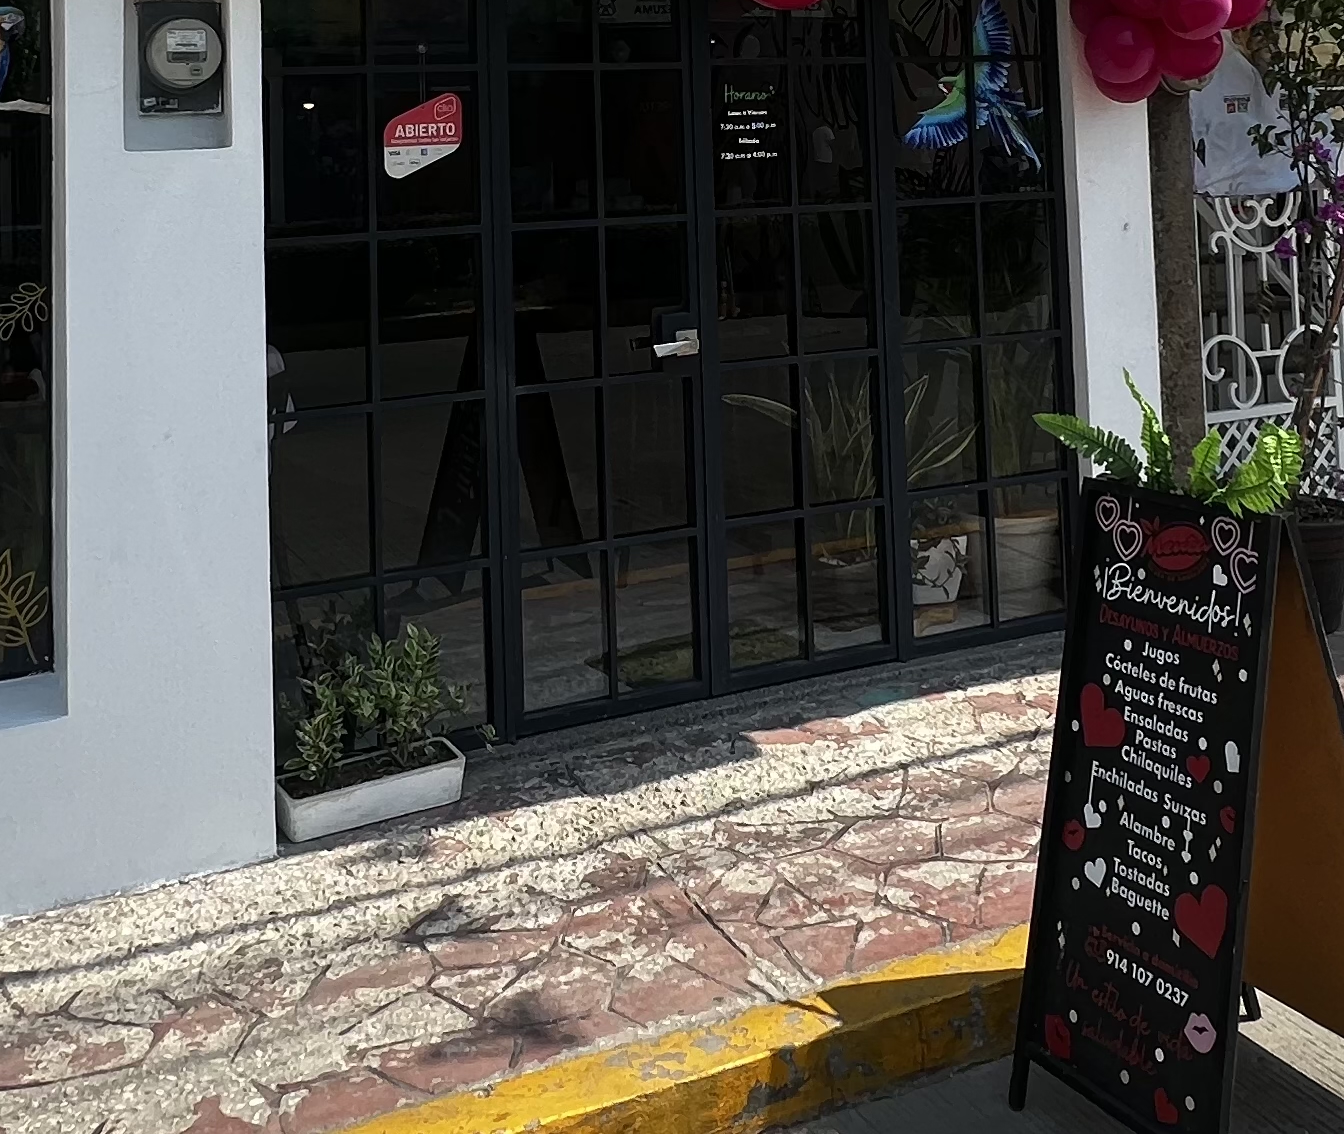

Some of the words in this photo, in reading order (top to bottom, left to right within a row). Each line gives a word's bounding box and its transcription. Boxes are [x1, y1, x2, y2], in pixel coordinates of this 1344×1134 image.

[394, 122, 456, 138] ABIERTO
[1142, 641, 1180, 665] Jugos
[1105, 652, 1156, 685] Cócteles
[1159, 671, 1176, 690] de
[1178, 677, 1218, 704] frutas
[1114, 679, 1155, 706] Aguas
[1157, 692, 1204, 723] frescas
[1123, 705, 1189, 743] Ensaladas
[1135, 729, 1177, 759] Pastas
[1092, 760, 1159, 803] Enchiladas
[1121, 745, 1193, 789] Chilaquiles
[1119, 811, 1176, 851] Alambre
[1127, 839, 1163, 869] Tacos
[1112, 856, 1170, 897] Tostadas
[1111, 876, 1170, 921] Baguette
[1106, 948, 1128, 974] 914
[1131, 962, 1155, 987] 107
[1155, 977, 1190, 1008] 0237
